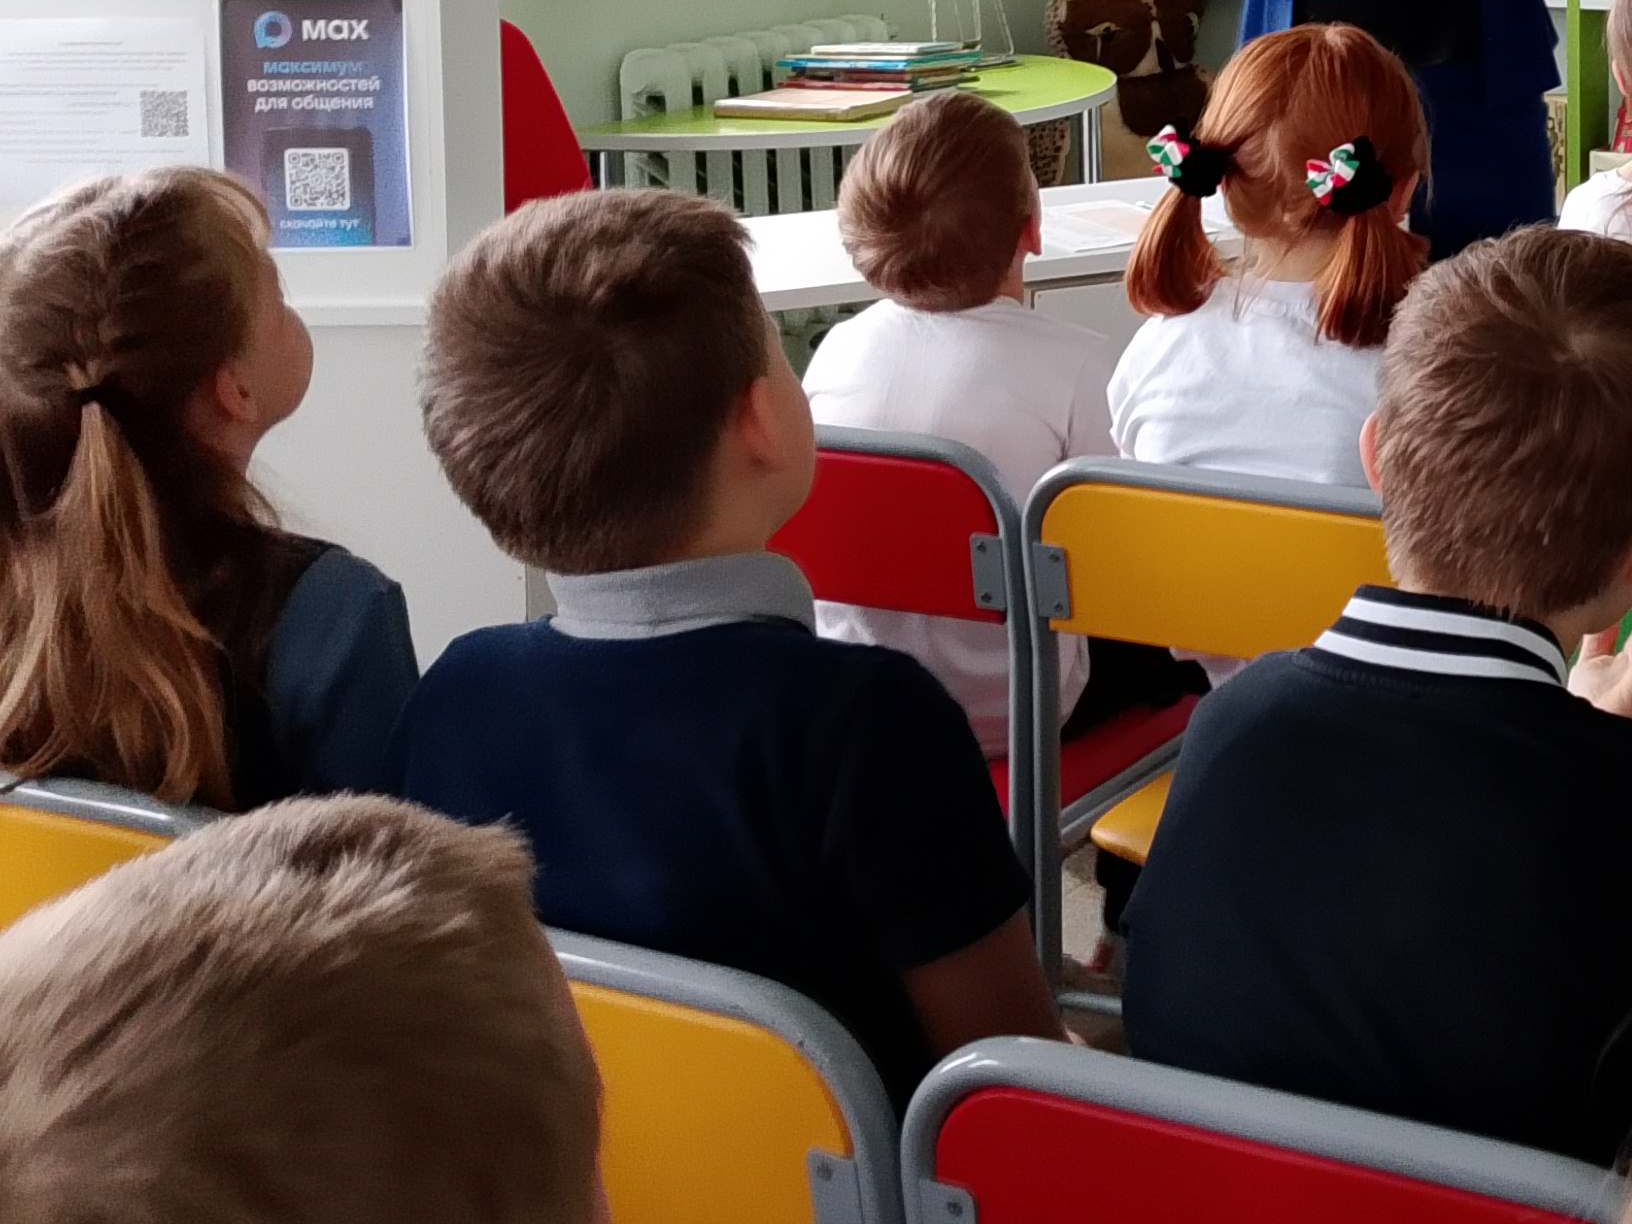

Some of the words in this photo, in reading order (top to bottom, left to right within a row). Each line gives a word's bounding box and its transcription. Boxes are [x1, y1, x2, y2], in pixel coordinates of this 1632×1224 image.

[263, 61, 363, 76] максимум
[247, 76, 380, 92] возможностей
[255, 96, 288, 113] для
[291, 94, 374, 112] общения
